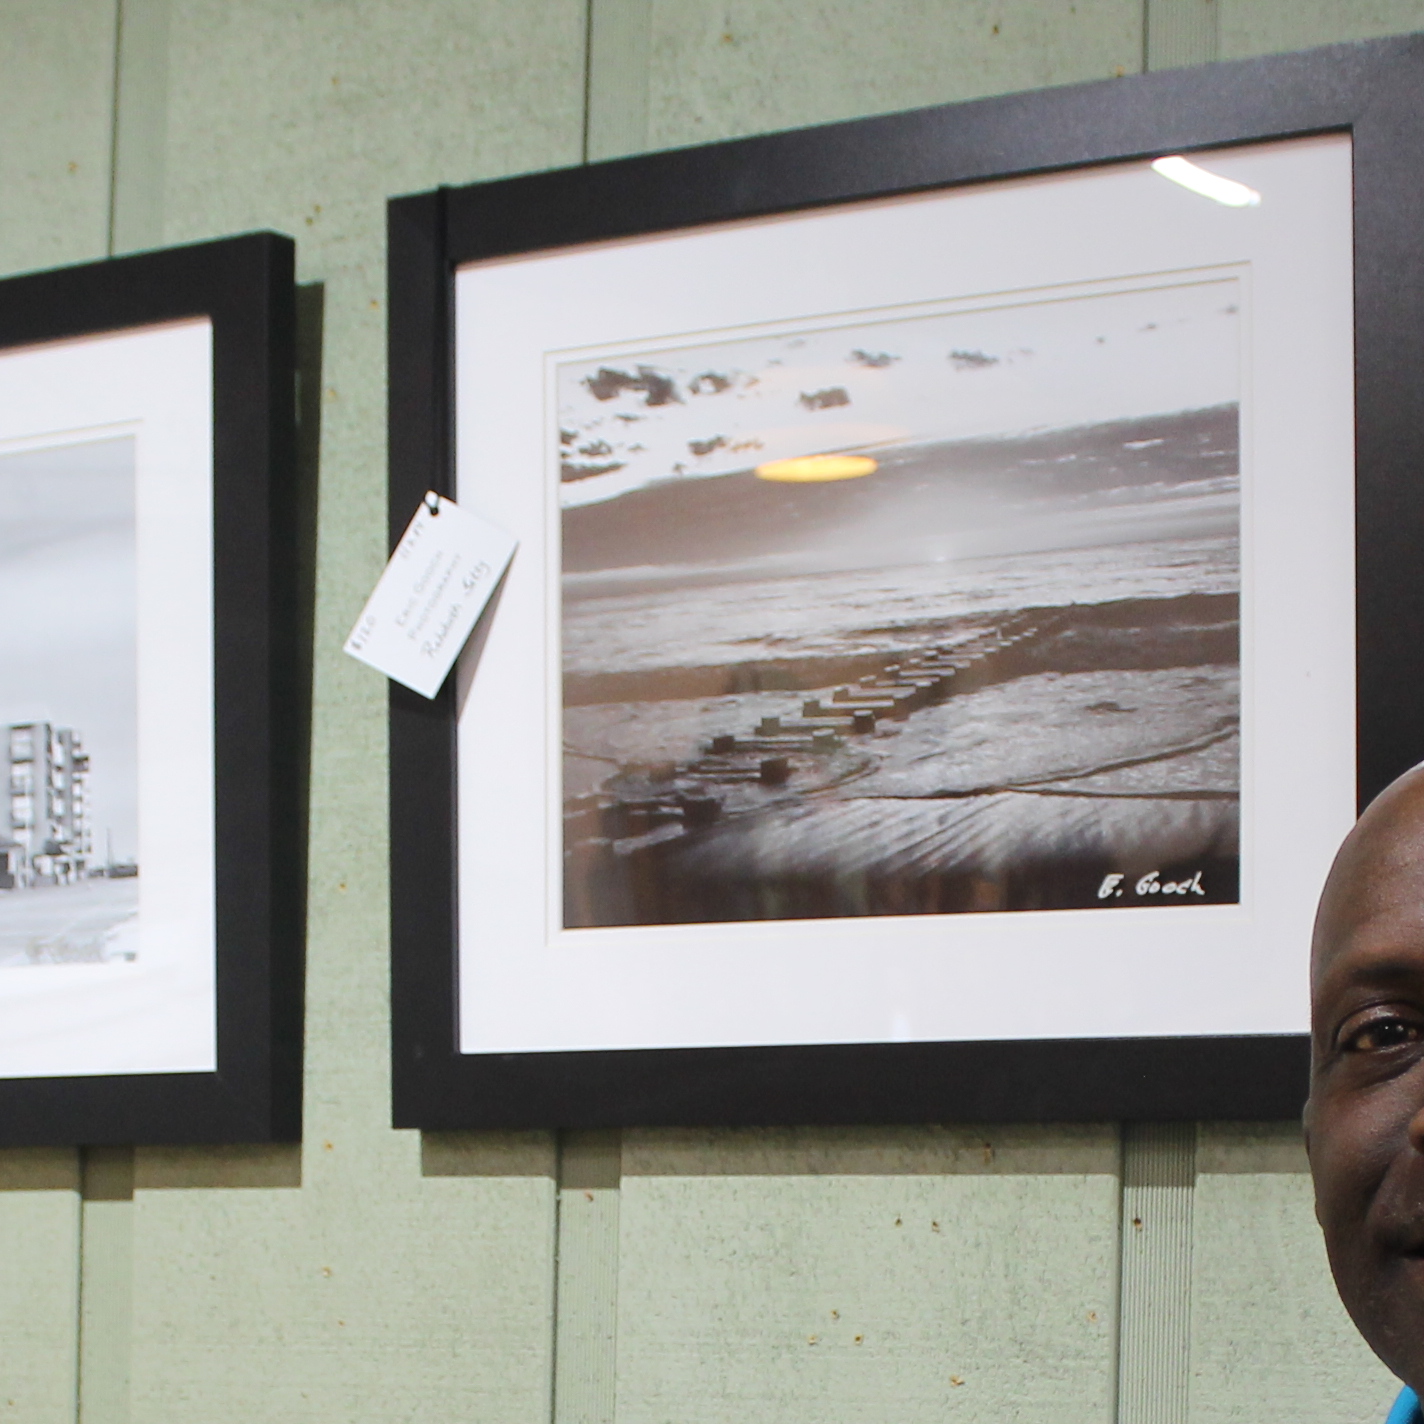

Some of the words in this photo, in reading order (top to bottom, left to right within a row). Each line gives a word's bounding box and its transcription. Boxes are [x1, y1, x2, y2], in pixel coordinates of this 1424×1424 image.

[395, 598, 417, 627] ERIC
[413, 550, 443, 594] GOOCH
[407, 554, 461, 641] PHOTOGRAPHY
[1136, 871, 1205, 895] Gooch
